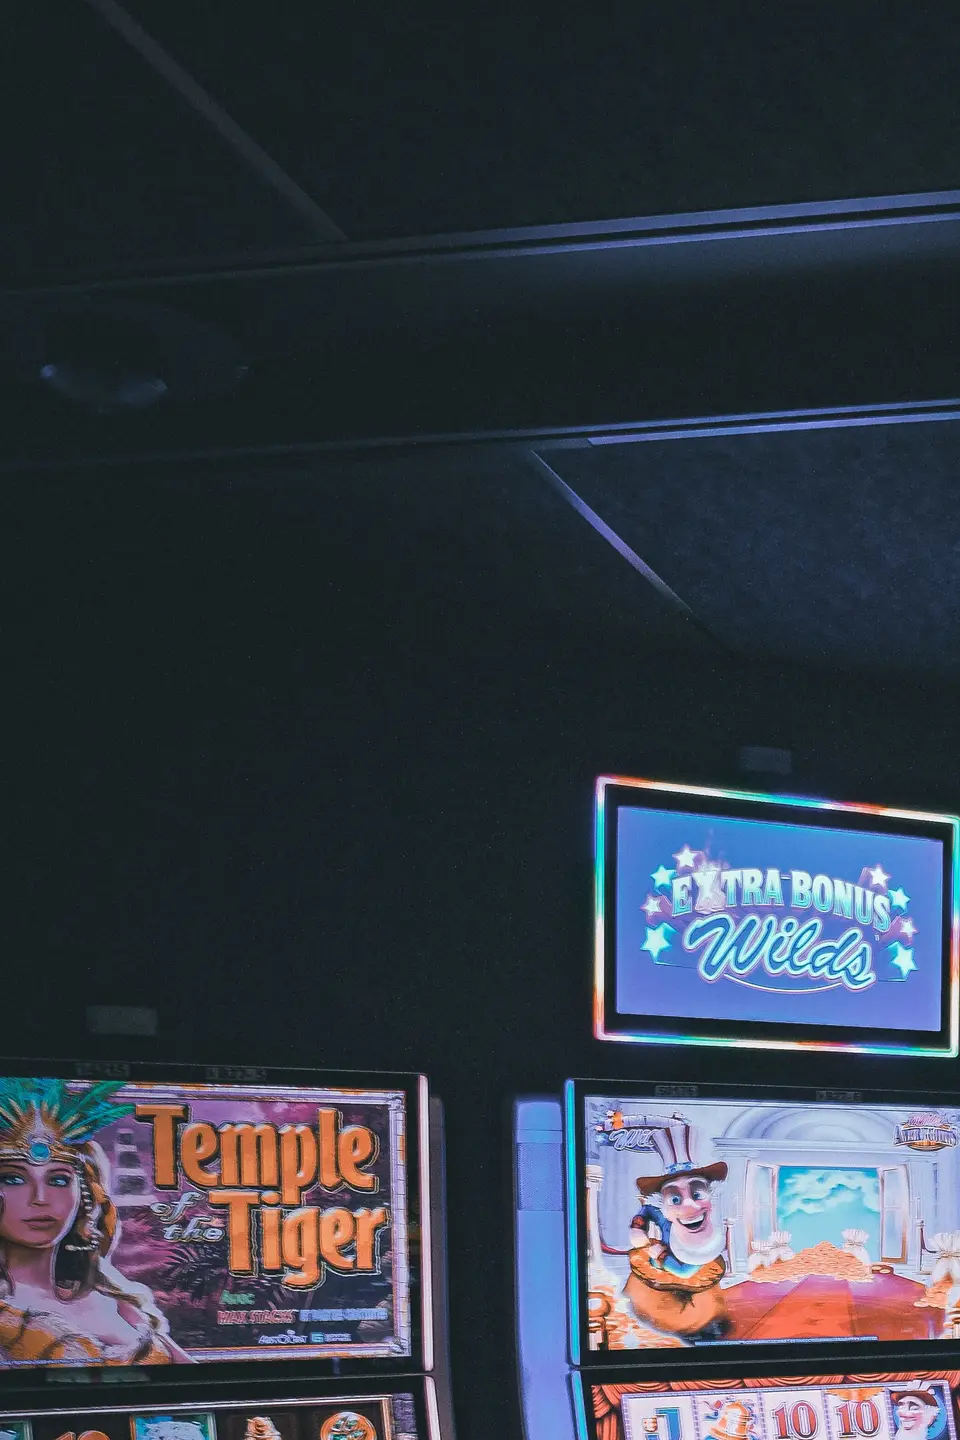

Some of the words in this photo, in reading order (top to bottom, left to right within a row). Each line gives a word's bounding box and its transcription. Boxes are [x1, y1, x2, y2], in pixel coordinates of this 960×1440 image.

[671, 865, 784, 917] EXTRA
[791, 870, 892, 933] BONUS
[683, 914, 877, 990] Wilds
[135, 1103, 379, 1206] Temple
[150, 1191, 205, 1222] of
[162, 1215, 225, 1242] the
[208, 1191, 391, 1289] Tiger
[836, 1396, 881, 1439] 10
